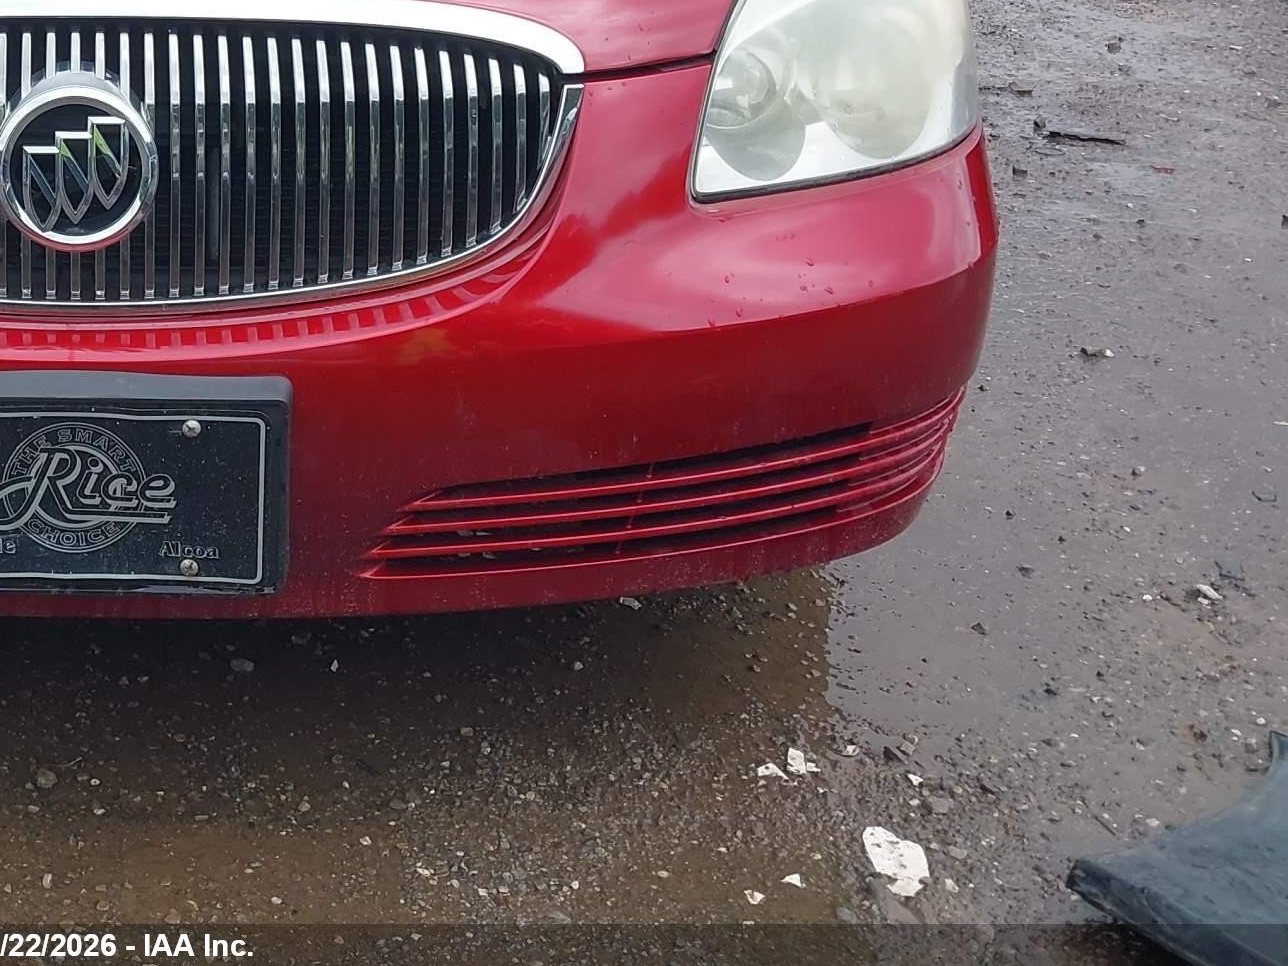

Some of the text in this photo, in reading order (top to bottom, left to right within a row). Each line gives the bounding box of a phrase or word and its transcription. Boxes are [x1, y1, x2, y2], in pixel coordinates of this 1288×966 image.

[12, 428, 136, 476] THE SMART
[28, 518, 121, 547] CHOICE
[158, 540, 219, 559] Alcoa
